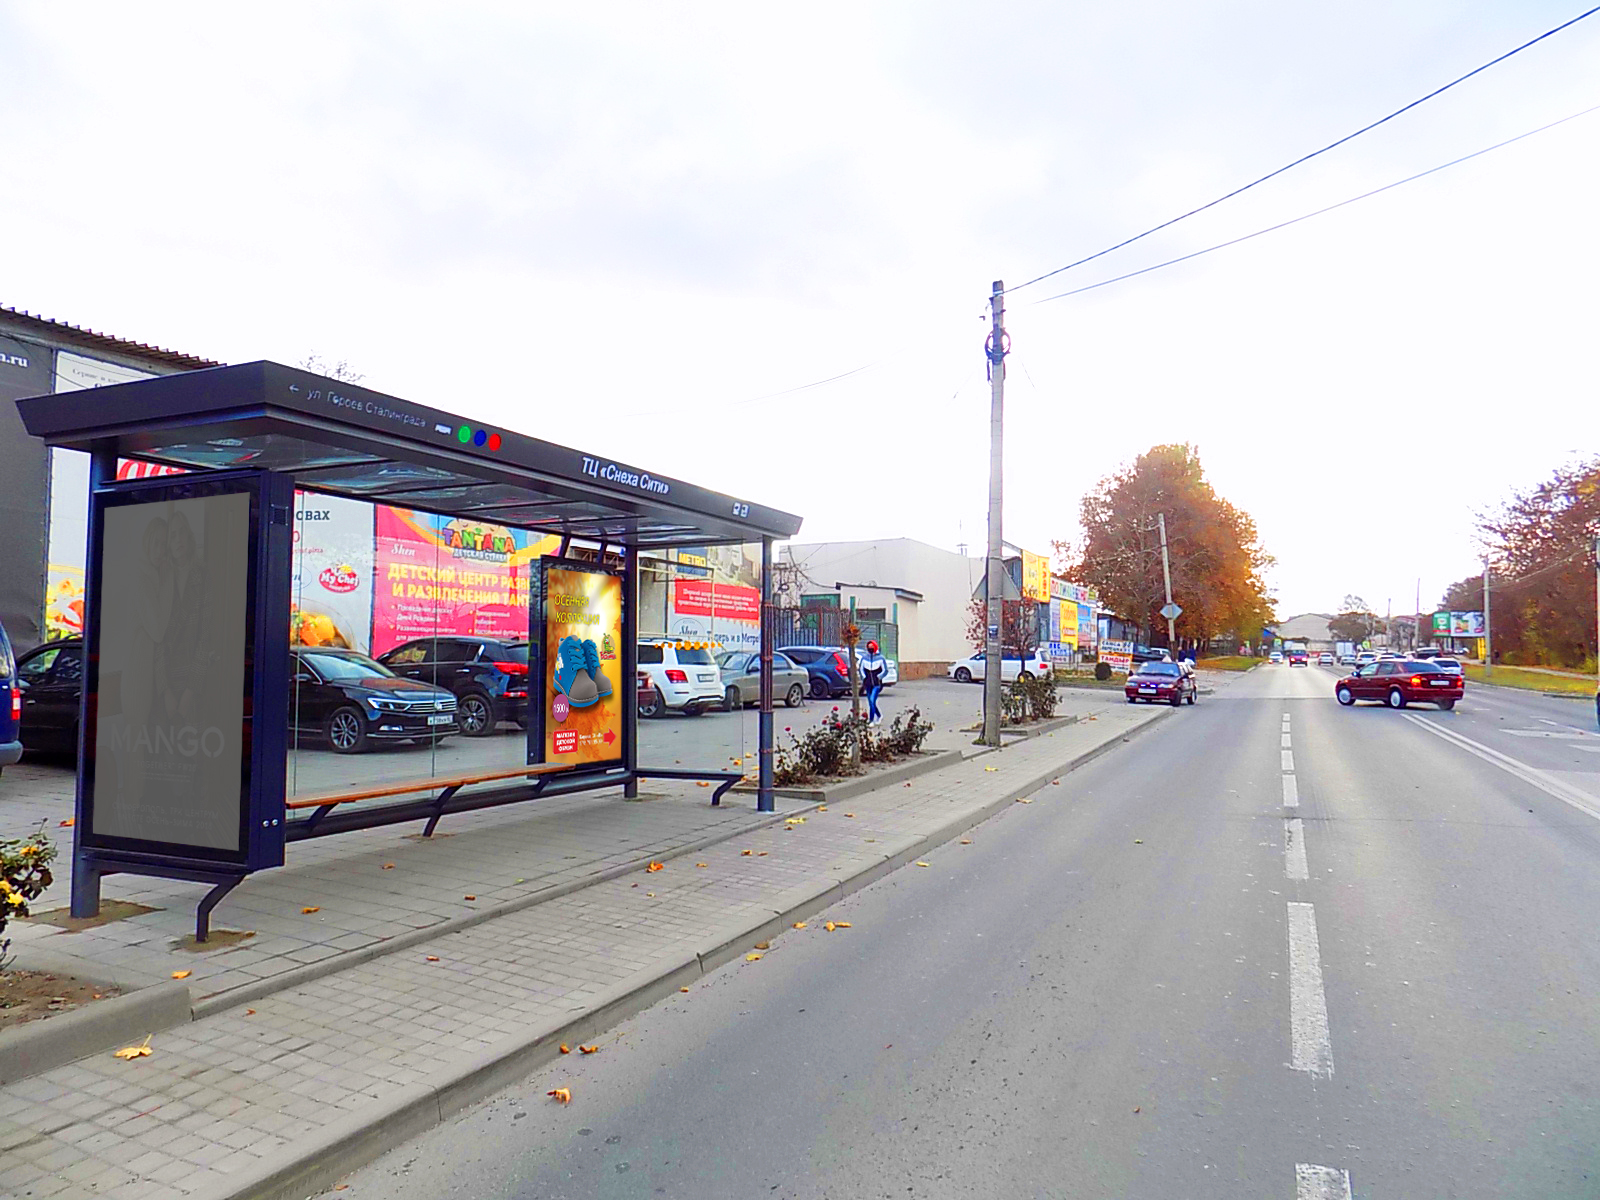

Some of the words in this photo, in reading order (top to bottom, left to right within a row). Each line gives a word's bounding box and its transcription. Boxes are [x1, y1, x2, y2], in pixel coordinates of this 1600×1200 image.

[327, 391, 363, 411] Героев
[365, 402, 426, 428] Сталинграда
[581, 456, 599, 479] ТЦ
[599, 464, 638, 487] «Снеха
[639, 474, 670, 495] Сити»
[443, 527, 516, 554] TANTANA
[337, 574, 359, 587] Chef
[388, 563, 456, 583] ДЕТСКИЙ
[458, 571, 499, 588] ЦЕНТР
[392, 583, 404, 598] И
[110, 723, 225, 758] MANGO
